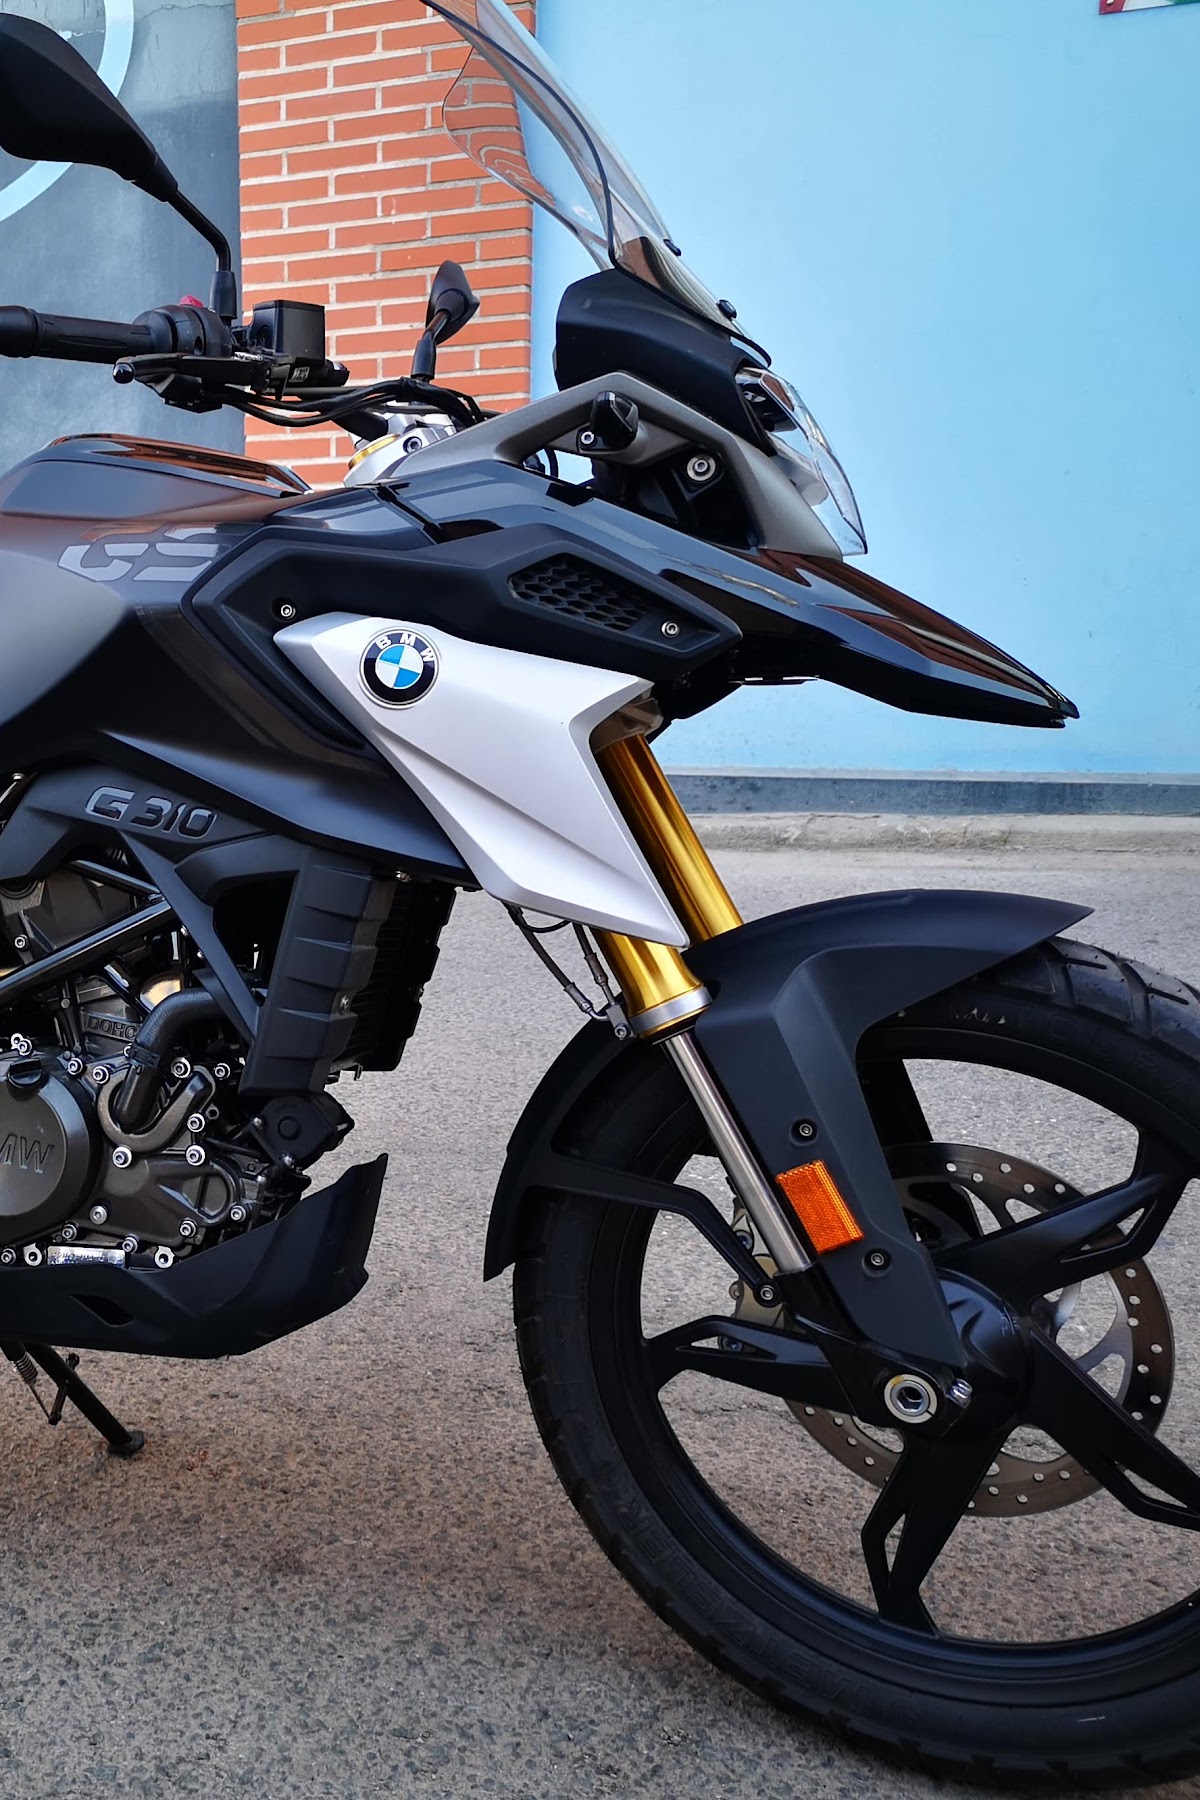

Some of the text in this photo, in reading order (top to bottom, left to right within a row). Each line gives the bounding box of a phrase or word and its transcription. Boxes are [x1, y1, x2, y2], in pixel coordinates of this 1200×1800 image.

[57, 522, 231, 583] GS
[375, 632, 436, 663] BMW
[85, 785, 218, 840] G 310
[87, 1015, 138, 1041] DOHC
